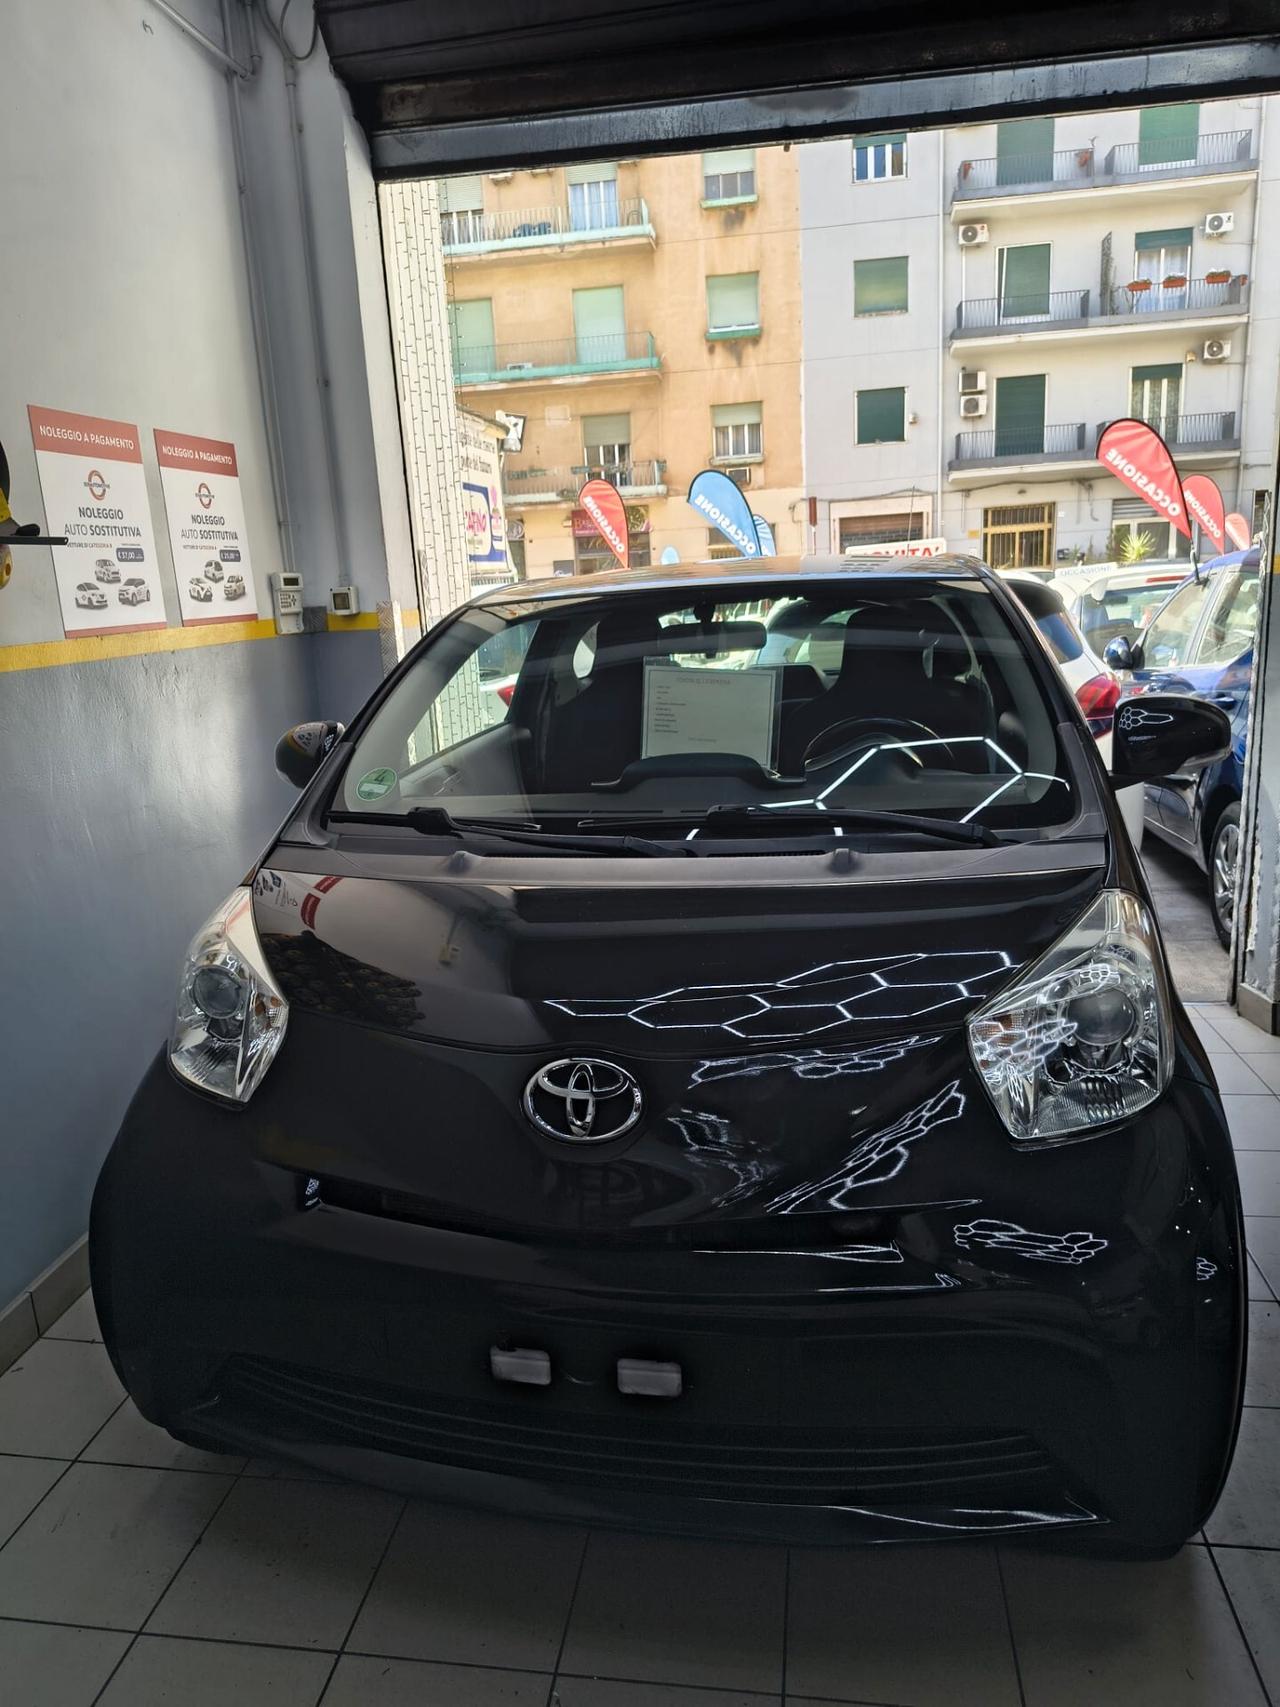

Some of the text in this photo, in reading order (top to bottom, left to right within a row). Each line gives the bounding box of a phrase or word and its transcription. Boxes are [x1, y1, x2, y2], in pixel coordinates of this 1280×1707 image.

[40, 425, 134, 450] NOLEGGIO A PAGAMENTO
[162, 445, 233, 465] NOLEGGIO A PAGAMENTO
[78, 506, 124, 520] NOLEGGIO
[191, 514, 225, 526] NOLEGGIO
[64, 523, 142, 537] AUTO SOSTITUTIVA
[181, 528, 239, 541] AUTO SOSTITUTIVA
